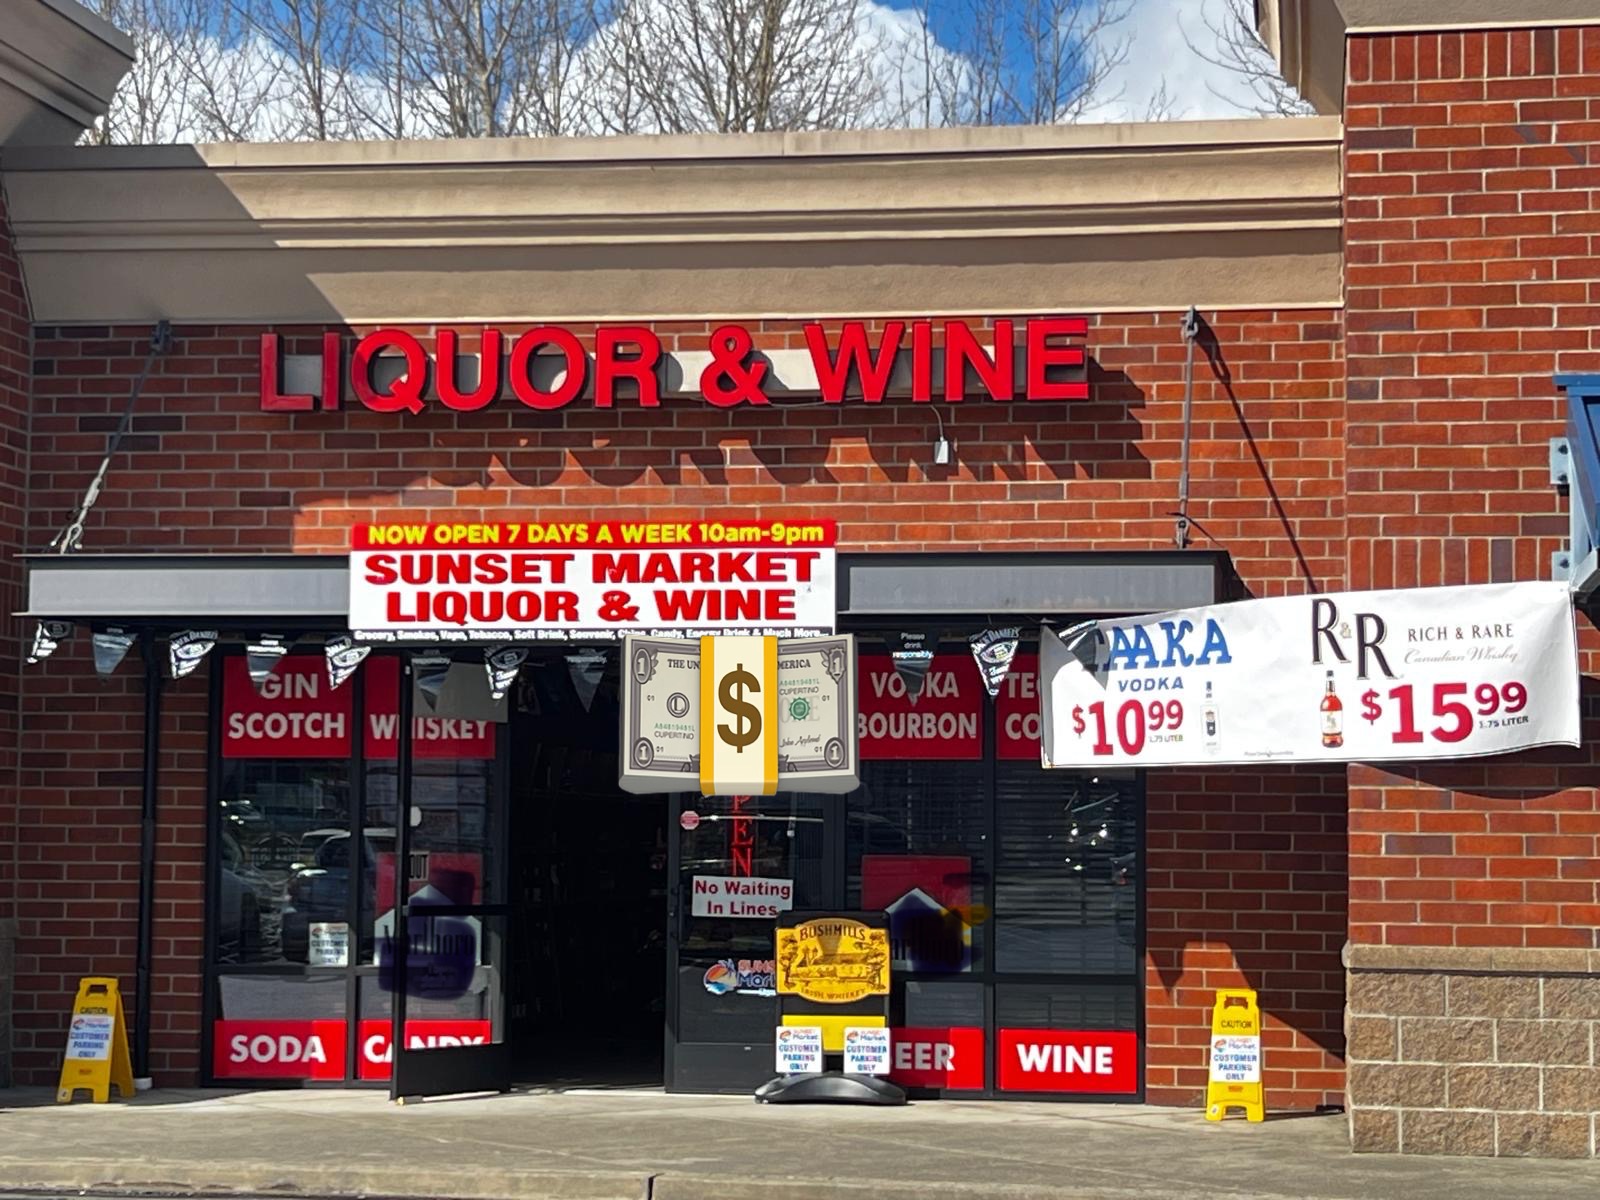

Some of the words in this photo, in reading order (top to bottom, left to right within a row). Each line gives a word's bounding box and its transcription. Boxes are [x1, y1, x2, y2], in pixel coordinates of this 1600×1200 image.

[259, 326, 661, 414] LIQUOR
[700, 324, 770, 408] &
[804, 318, 1091, 404] WINE
[368, 526, 428, 545] NOW
[432, 525, 503, 544] OPEN
[506, 525, 520, 543] 7
[526, 524, 589, 544] DAYS
[595, 525, 614, 543] A
[617, 523, 692, 543] WEEK
[699, 523, 825, 546] 10am-9pm
[364, 551, 575, 585] SUNSET
[592, 550, 820, 583] MARKET
[386, 590, 580, 626] LIQUOR
[598, 590, 640, 622] &
[653, 588, 797, 621] WINE
[514, 629, 536, 640] Soft
[1407, 626, 1449, 643] RICH
[1455, 626, 1465, 640] &
[1471, 623, 1515, 639] RARE
[1083, 618, 1233, 672] AAKA
[260, 672, 319, 699] GIN
[870, 671, 960, 698] VOKA
[1117, 676, 1185, 692] VODKA
[228, 712, 346, 740] SCOTCH
[857, 712, 977, 739] BOURBON
[1501, 715, 1529, 727] LITER
[694, 880, 719, 895] No
[724, 880, 791, 900] Waiting
[707, 900, 724, 914] In
[730, 901, 779, 917] Lines
[799, 923, 866, 942] BUSHMILLS
[1220, 1019, 1252, 1028] CAUTION
[229, 1034, 327, 1063] SODA
[778, 1044, 820, 1053] CUSTOMER
[783, 1053, 816, 1062] PARKING
[846, 1045, 887, 1054] CUSTOMER
[892, 1041, 956, 1071] EER
[1213, 1053, 1257, 1062] CUSTOMER
[789, 1062, 809, 1071] ONLY
[850, 1054, 883, 1063] PARKING
[857, 1063, 877, 1072] ONLY
[1015, 1043, 1114, 1074] WINE
[1218, 1063, 1253, 1071] PARKING
[1225, 1073, 1246, 1081] ONLY
